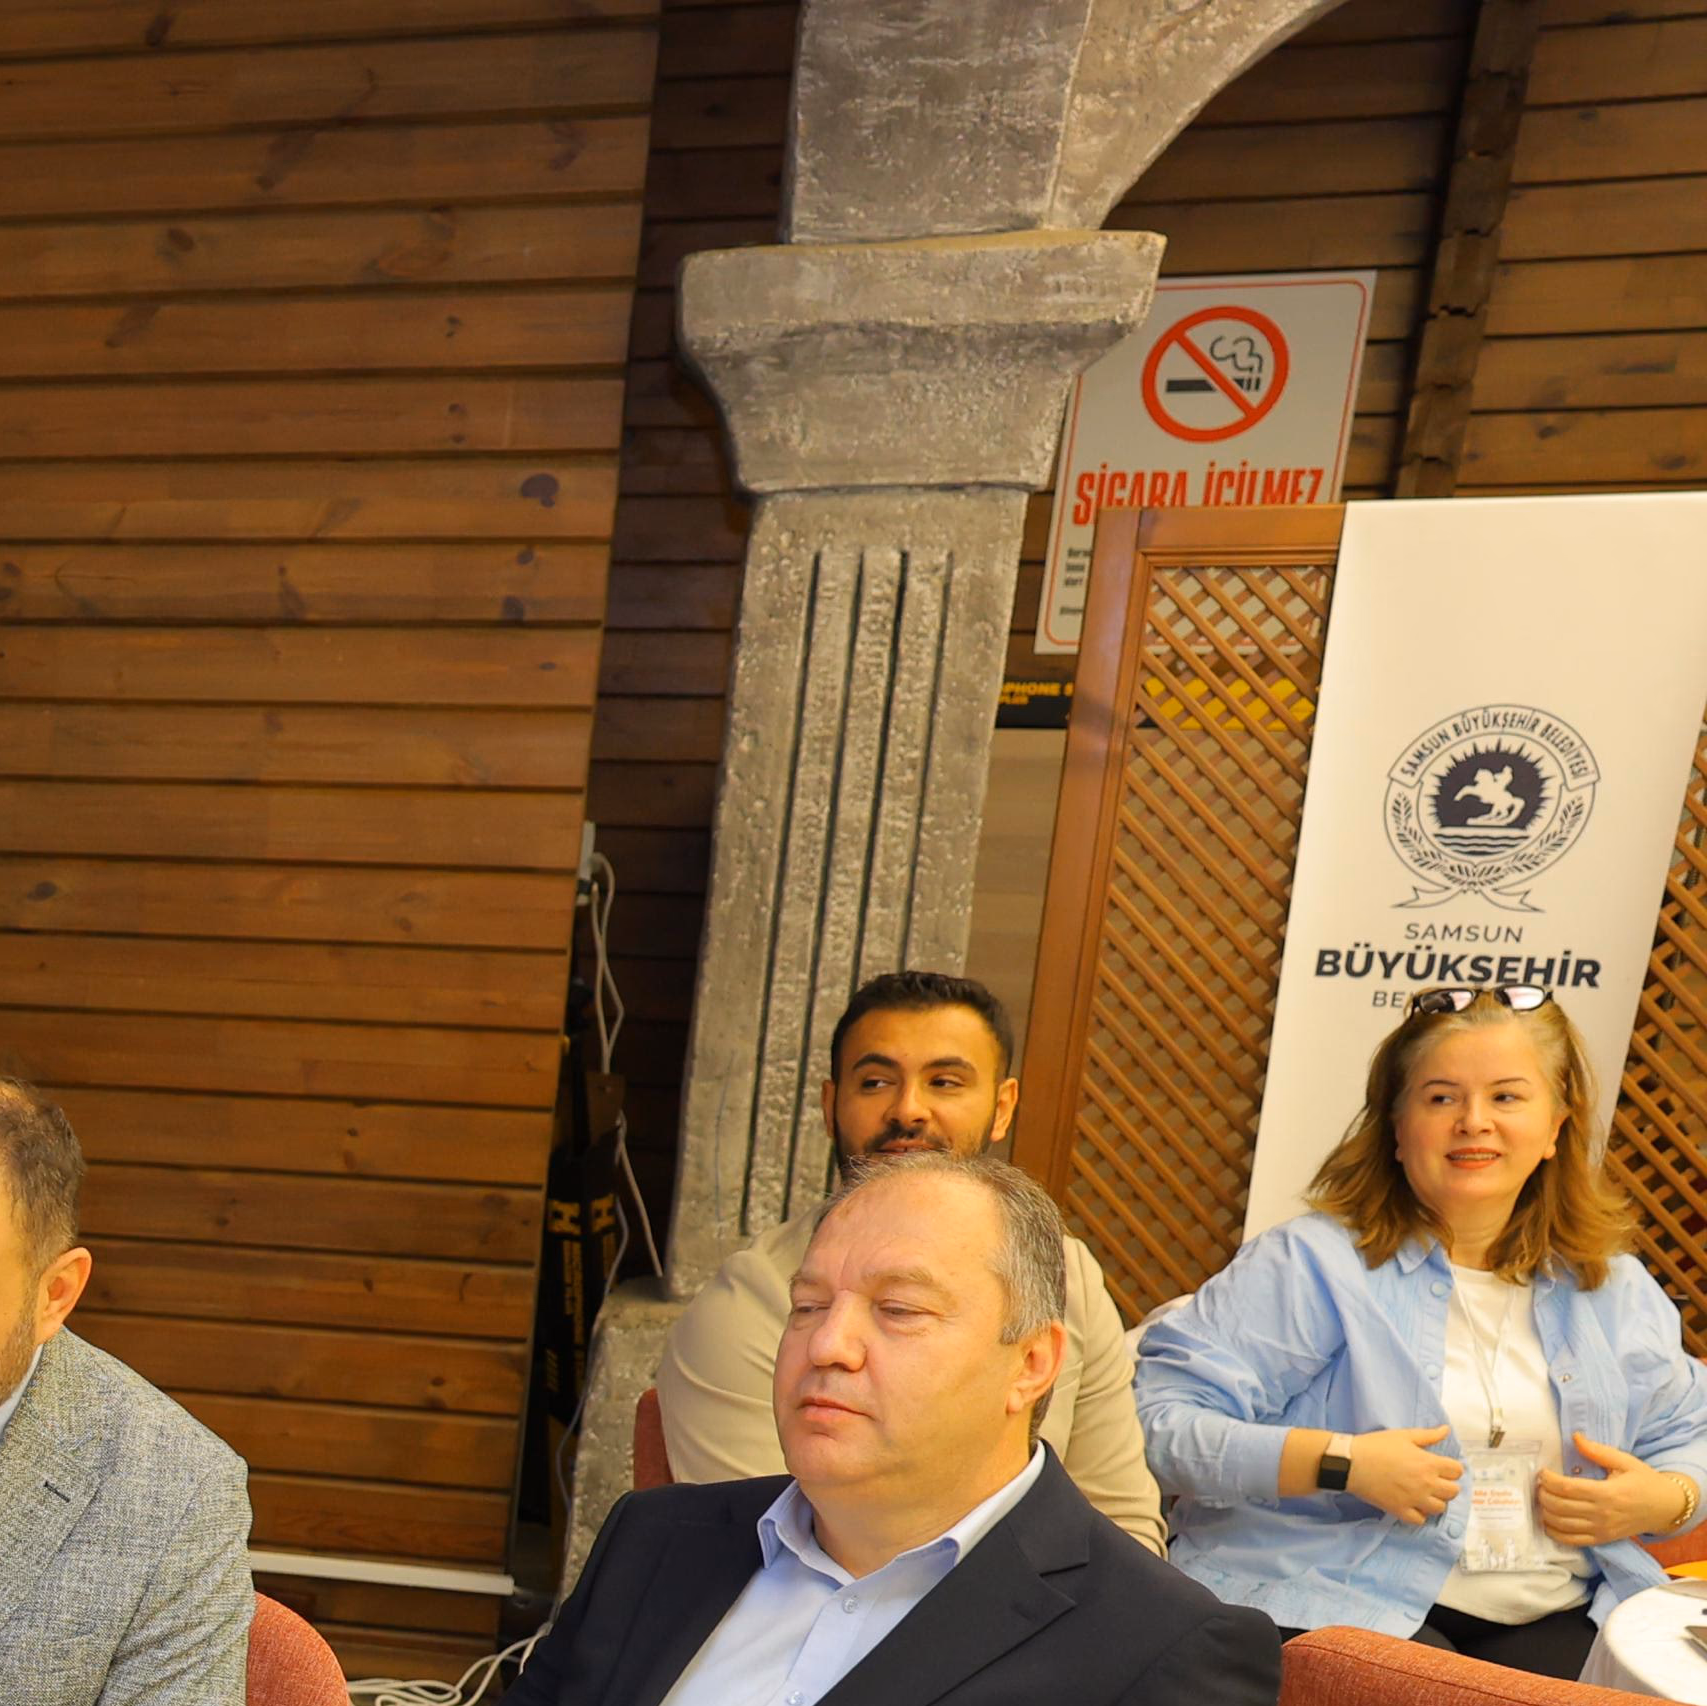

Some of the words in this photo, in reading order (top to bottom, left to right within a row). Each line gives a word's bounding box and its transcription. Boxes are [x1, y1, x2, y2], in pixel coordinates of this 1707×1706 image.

[1399, 727, 1453, 777] SAMSUN
[1452, 709, 1541, 737] BÜYÜKŞEHİR
[1538, 718, 1590, 780] BELEDİYESİ
[1404, 922, 1524, 944] SAMSUN
